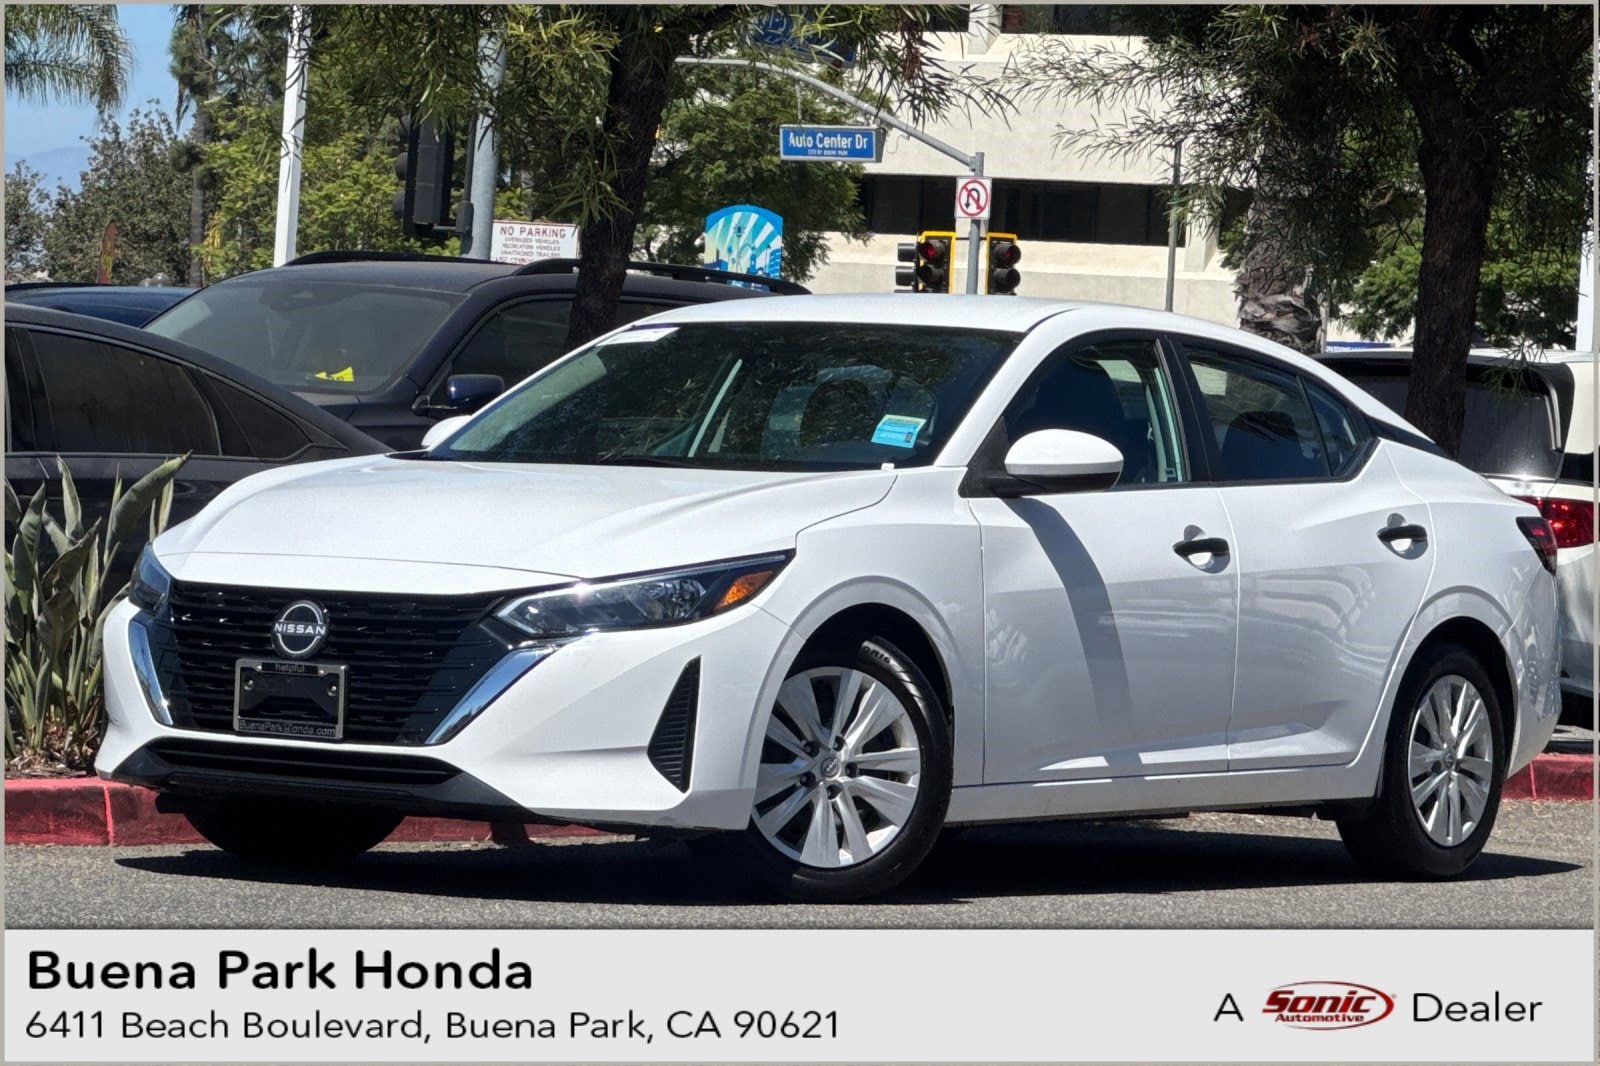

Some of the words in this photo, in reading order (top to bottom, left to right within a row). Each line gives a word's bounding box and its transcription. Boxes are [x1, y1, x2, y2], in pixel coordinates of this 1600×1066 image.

[788, 132, 813, 148] Auto
[816, 132, 852, 149] Center
[855, 133, 868, 149] Dr
[500, 226, 515, 236] NO
[519, 226, 566, 239] PARKING
[274, 623, 326, 635] NISSAN
[275, 662, 305, 672] helpful
